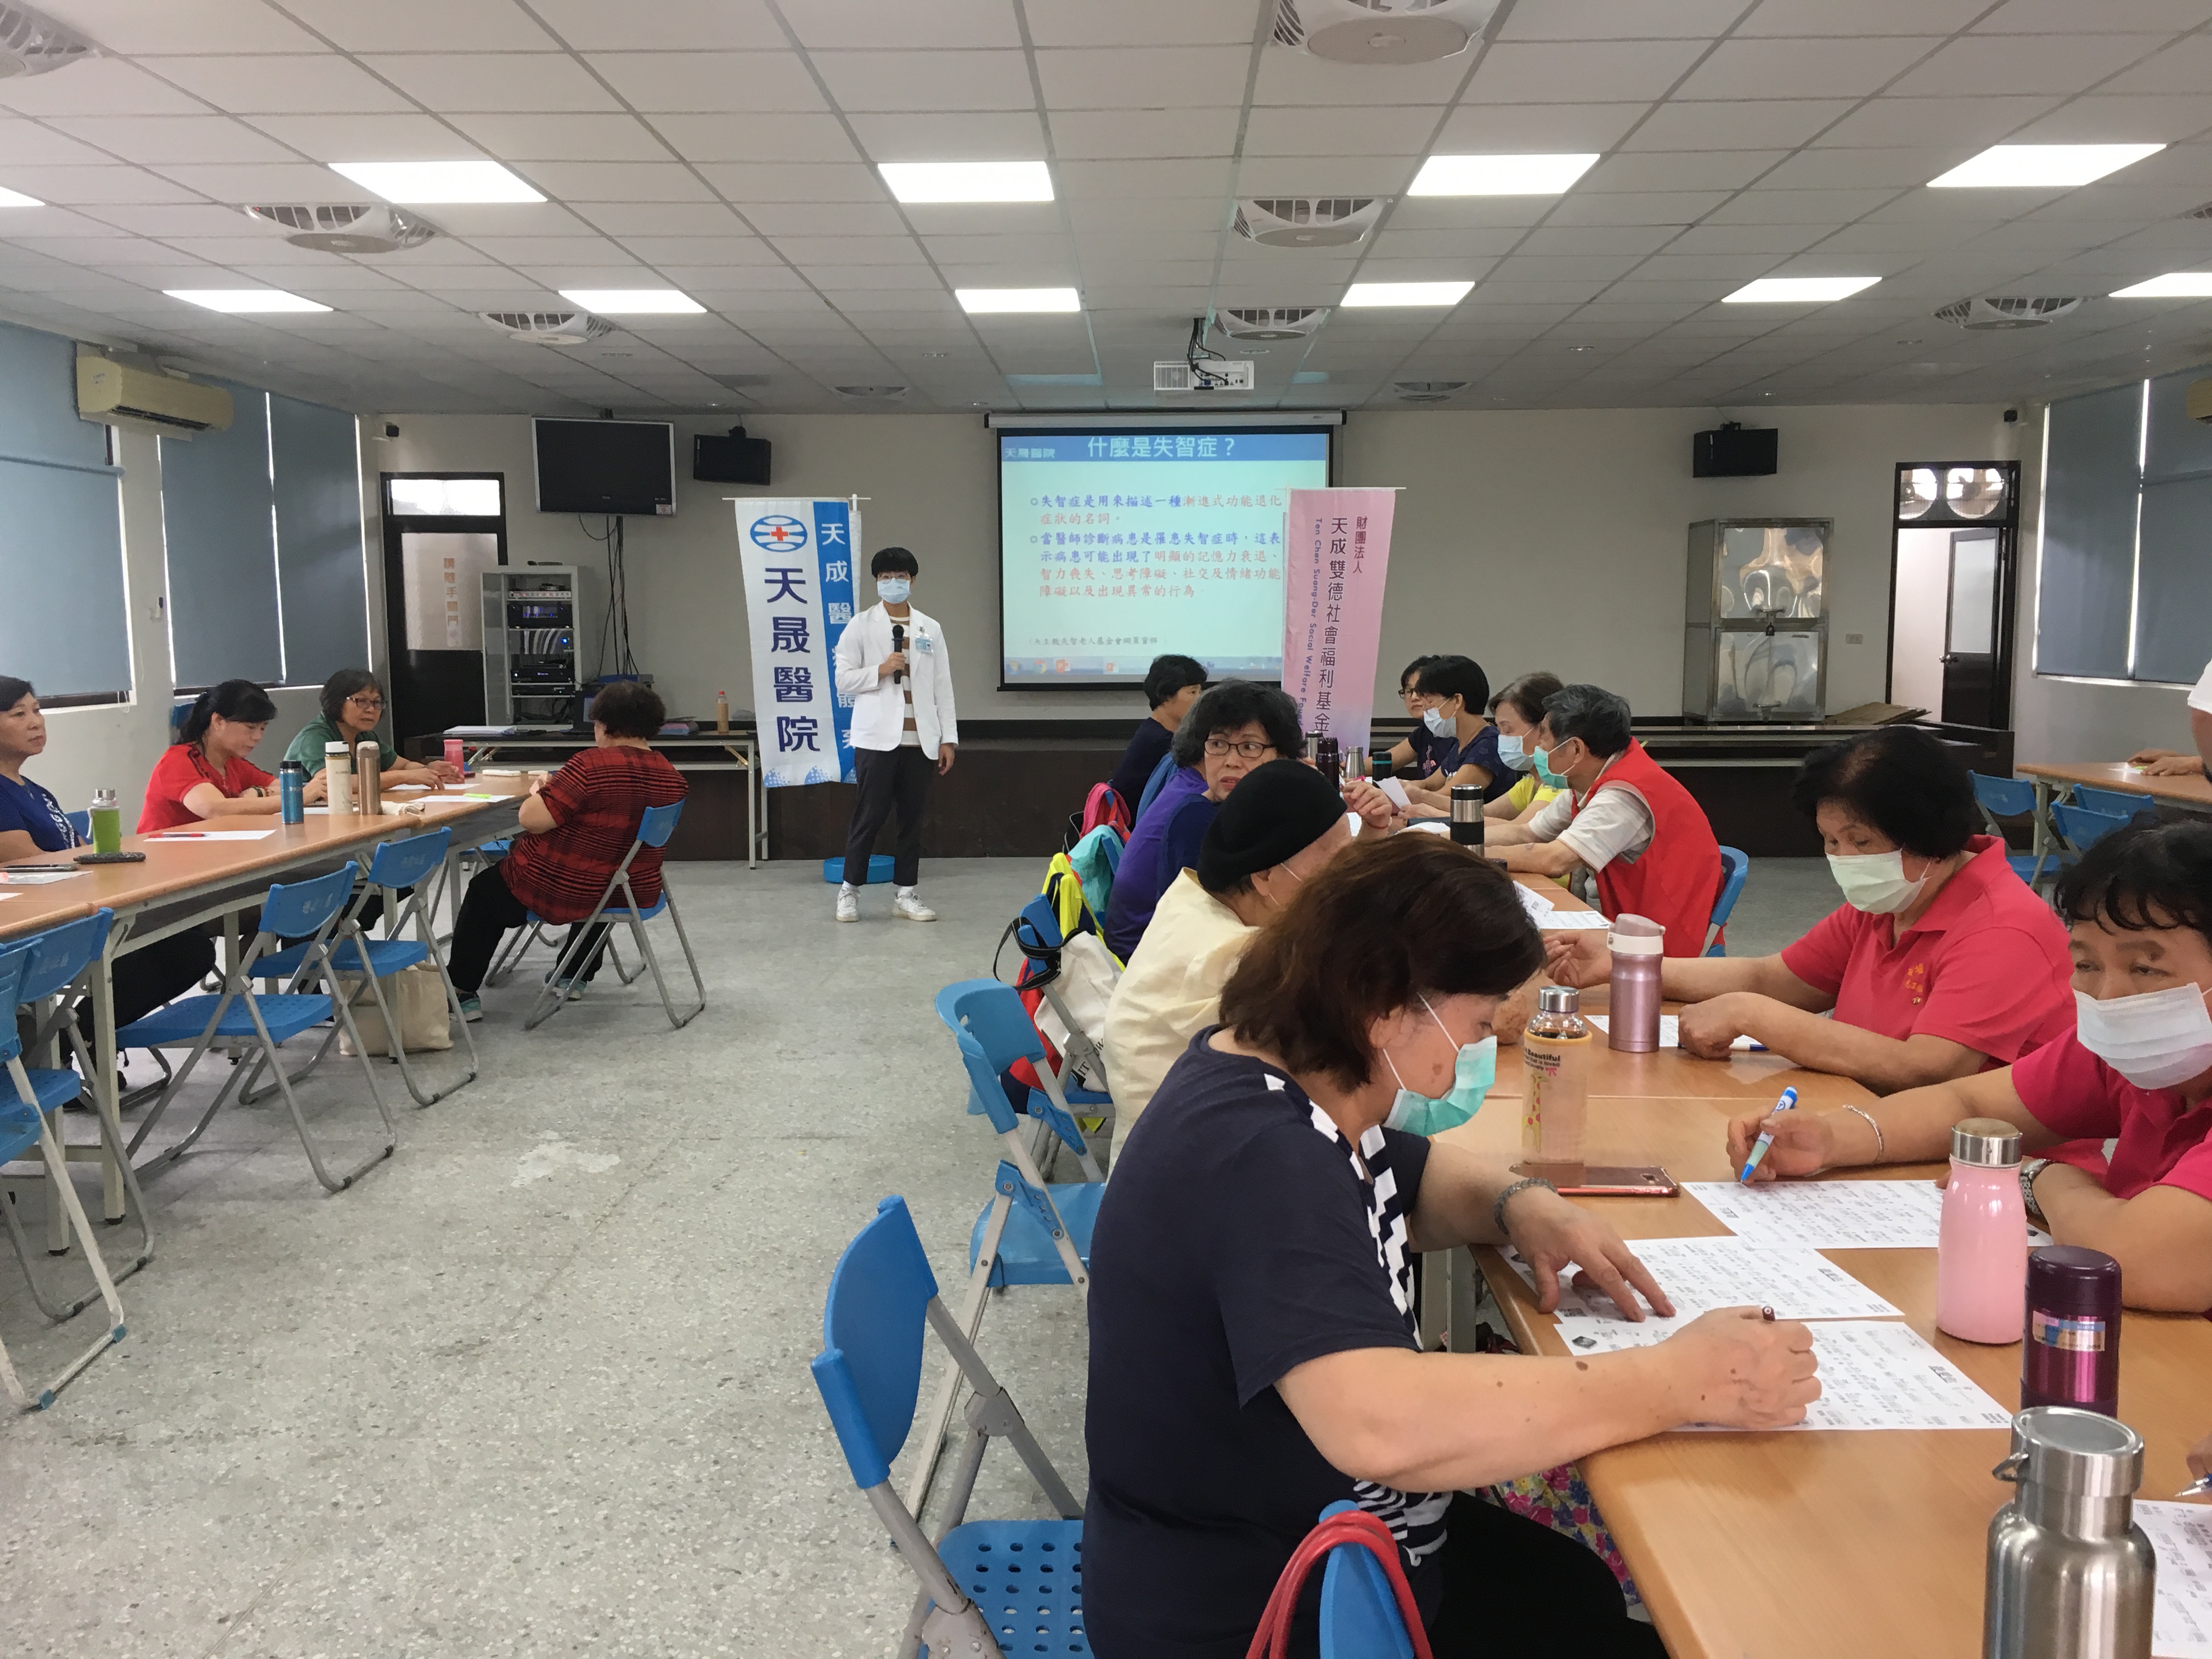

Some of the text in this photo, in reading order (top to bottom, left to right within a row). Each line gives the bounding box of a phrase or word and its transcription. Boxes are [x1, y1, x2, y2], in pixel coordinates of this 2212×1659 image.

[1087, 436, 1235, 458] 什麼是失智症？
[1352, 516, 1368, 574] 財團法人
[1307, 623, 1317, 651] Social
[764, 568, 821, 752] 天晟醫院
[1300, 655, 1313, 693] Welfare
